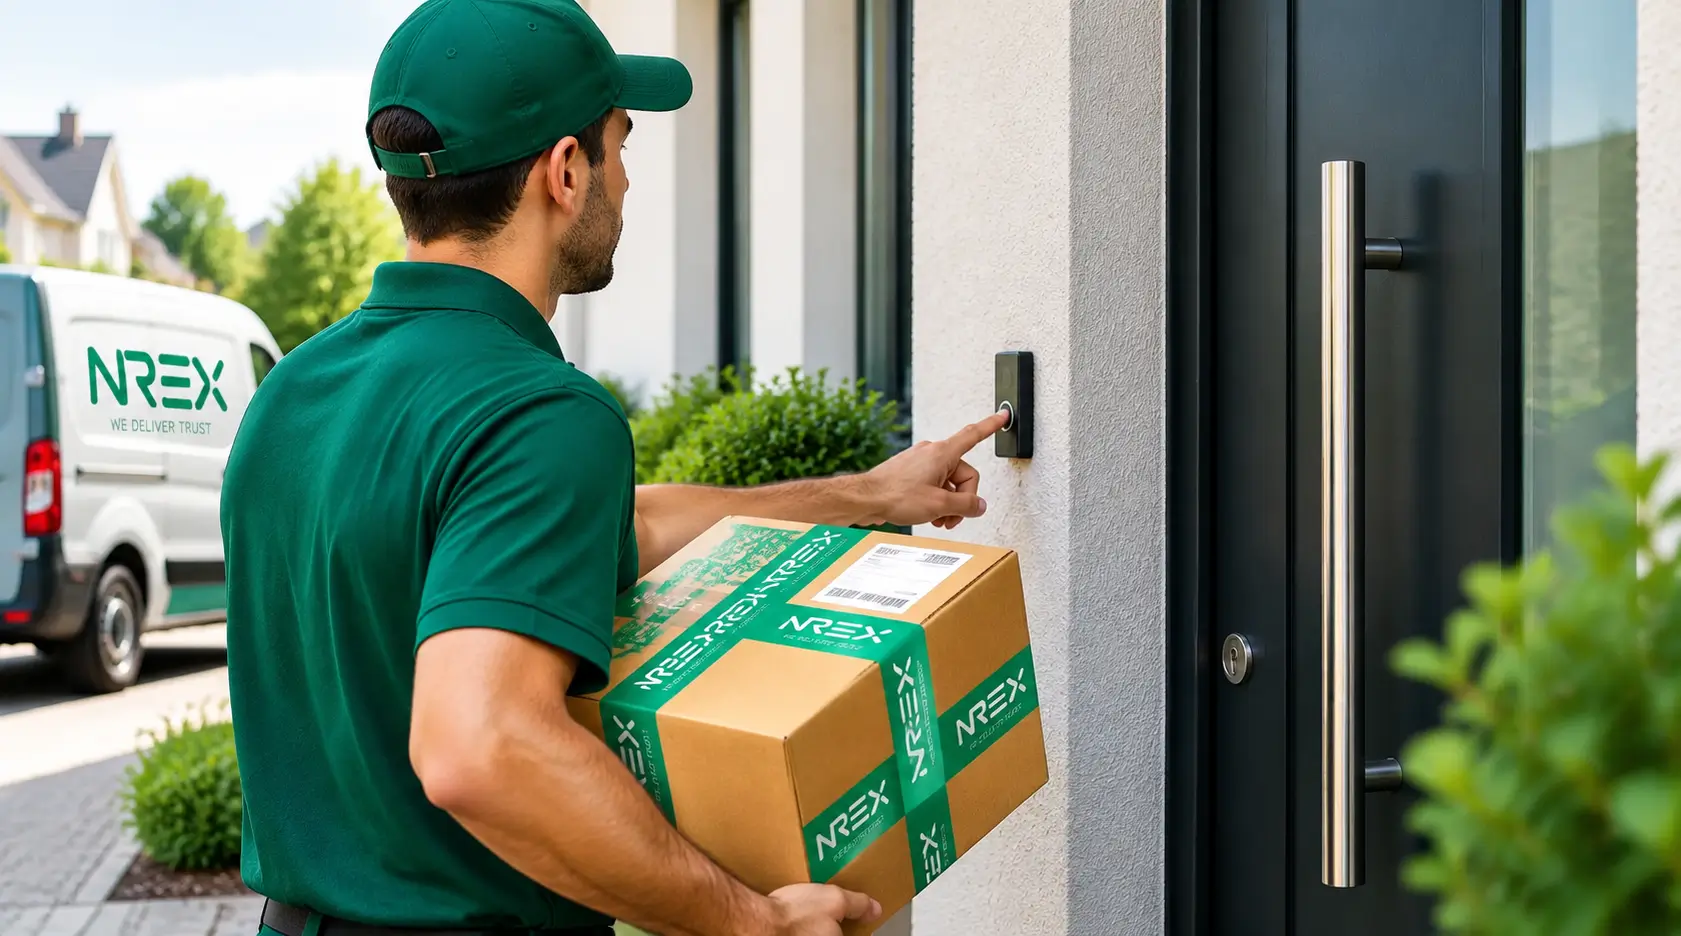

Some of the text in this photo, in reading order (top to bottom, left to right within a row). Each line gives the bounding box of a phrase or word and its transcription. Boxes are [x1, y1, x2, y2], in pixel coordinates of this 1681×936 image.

[87, 346, 228, 412] NREX
[110, 418, 212, 435] WE DELIVER TRUST
[778, 615, 893, 644] NREX
[956, 667, 1027, 746] NREX
[816, 779, 890, 861] NREX
